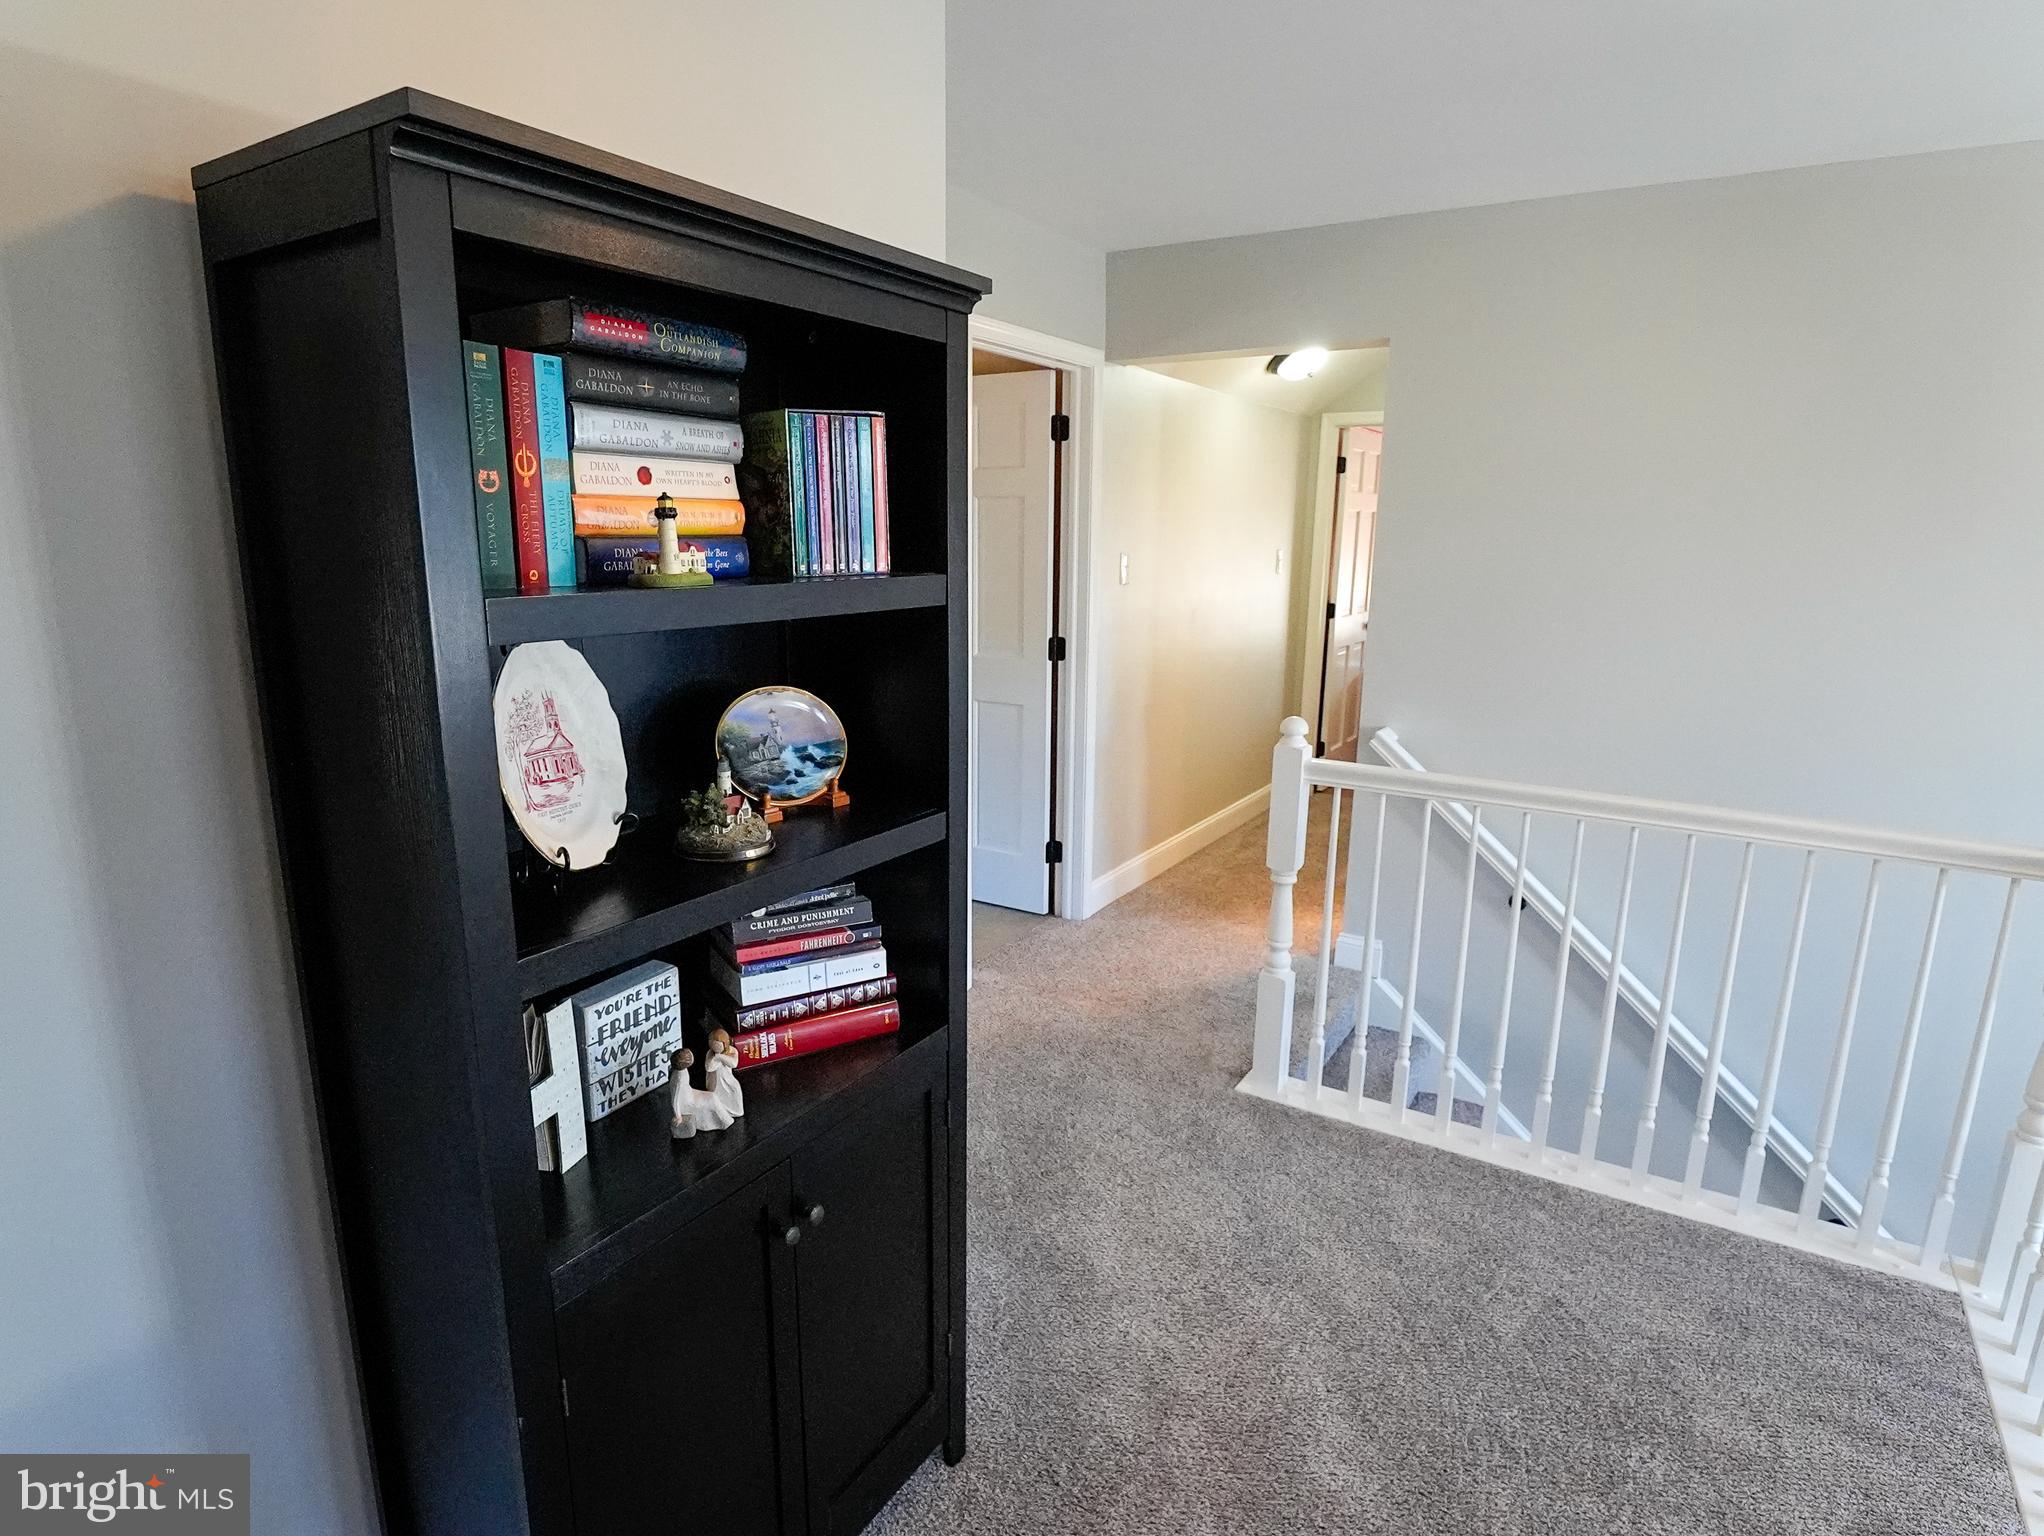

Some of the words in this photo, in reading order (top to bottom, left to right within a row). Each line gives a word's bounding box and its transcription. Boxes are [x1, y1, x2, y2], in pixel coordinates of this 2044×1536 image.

[590, 325, 644, 341] GABALDON
[601, 318, 633, 330] DIANA
[660, 337, 721, 361] COMPANION
[588, 367, 623, 382] DIANA
[575, 378, 634, 396] GABALDON
[667, 381, 679, 390] AN
[681, 383, 703, 393] ECHO
[510, 367, 523, 440] GABALDON
[521, 381, 532, 424] DIANA
[659, 390, 669, 399] IN
[672, 391, 687, 401] THE
[690, 393, 711, 404] BONE
[471, 382, 488, 457] GABALDON
[486, 397, 497, 442] DIANA
[541, 383, 553, 453] GABALDON
[551, 395, 561, 438] DIANA
[612, 418, 649, 432] DIANA
[599, 433, 660, 449] GABALDON
[689, 428, 714, 439] BREATH
[675, 442, 695, 452] SNOW
[696, 444, 711, 454] AND
[712, 445, 731, 457] ASHES
[589, 461, 621, 473] DIANA
[664, 469, 695, 478] WRITTEN
[580, 474, 633, 486] GABALDON
[596, 505, 628, 515] DIANA
[520, 503, 531, 543] CROSS
[586, 519, 640, 530] GABALDON
[486, 503, 499, 567] VOYAGER
[531, 521, 542, 555] FIERY
[603, 561, 634, 572] GABAL
[715, 560, 730, 572] Gone
[750, 917, 779, 931] CRIME
[781, 915, 799, 928] AND
[801, 906, 855, 923] PUNISHMENT
[800, 934, 843, 952] FAHRENHEIT
[594, 989, 643, 1020] YOU'RE
[645, 975, 672, 996] THE
[596, 994, 673, 1047] FRIEND
[595, 1016, 678, 1067] everyone
[597, 1041, 673, 1097] WISHES
[598, 1083, 640, 1113] THEY
